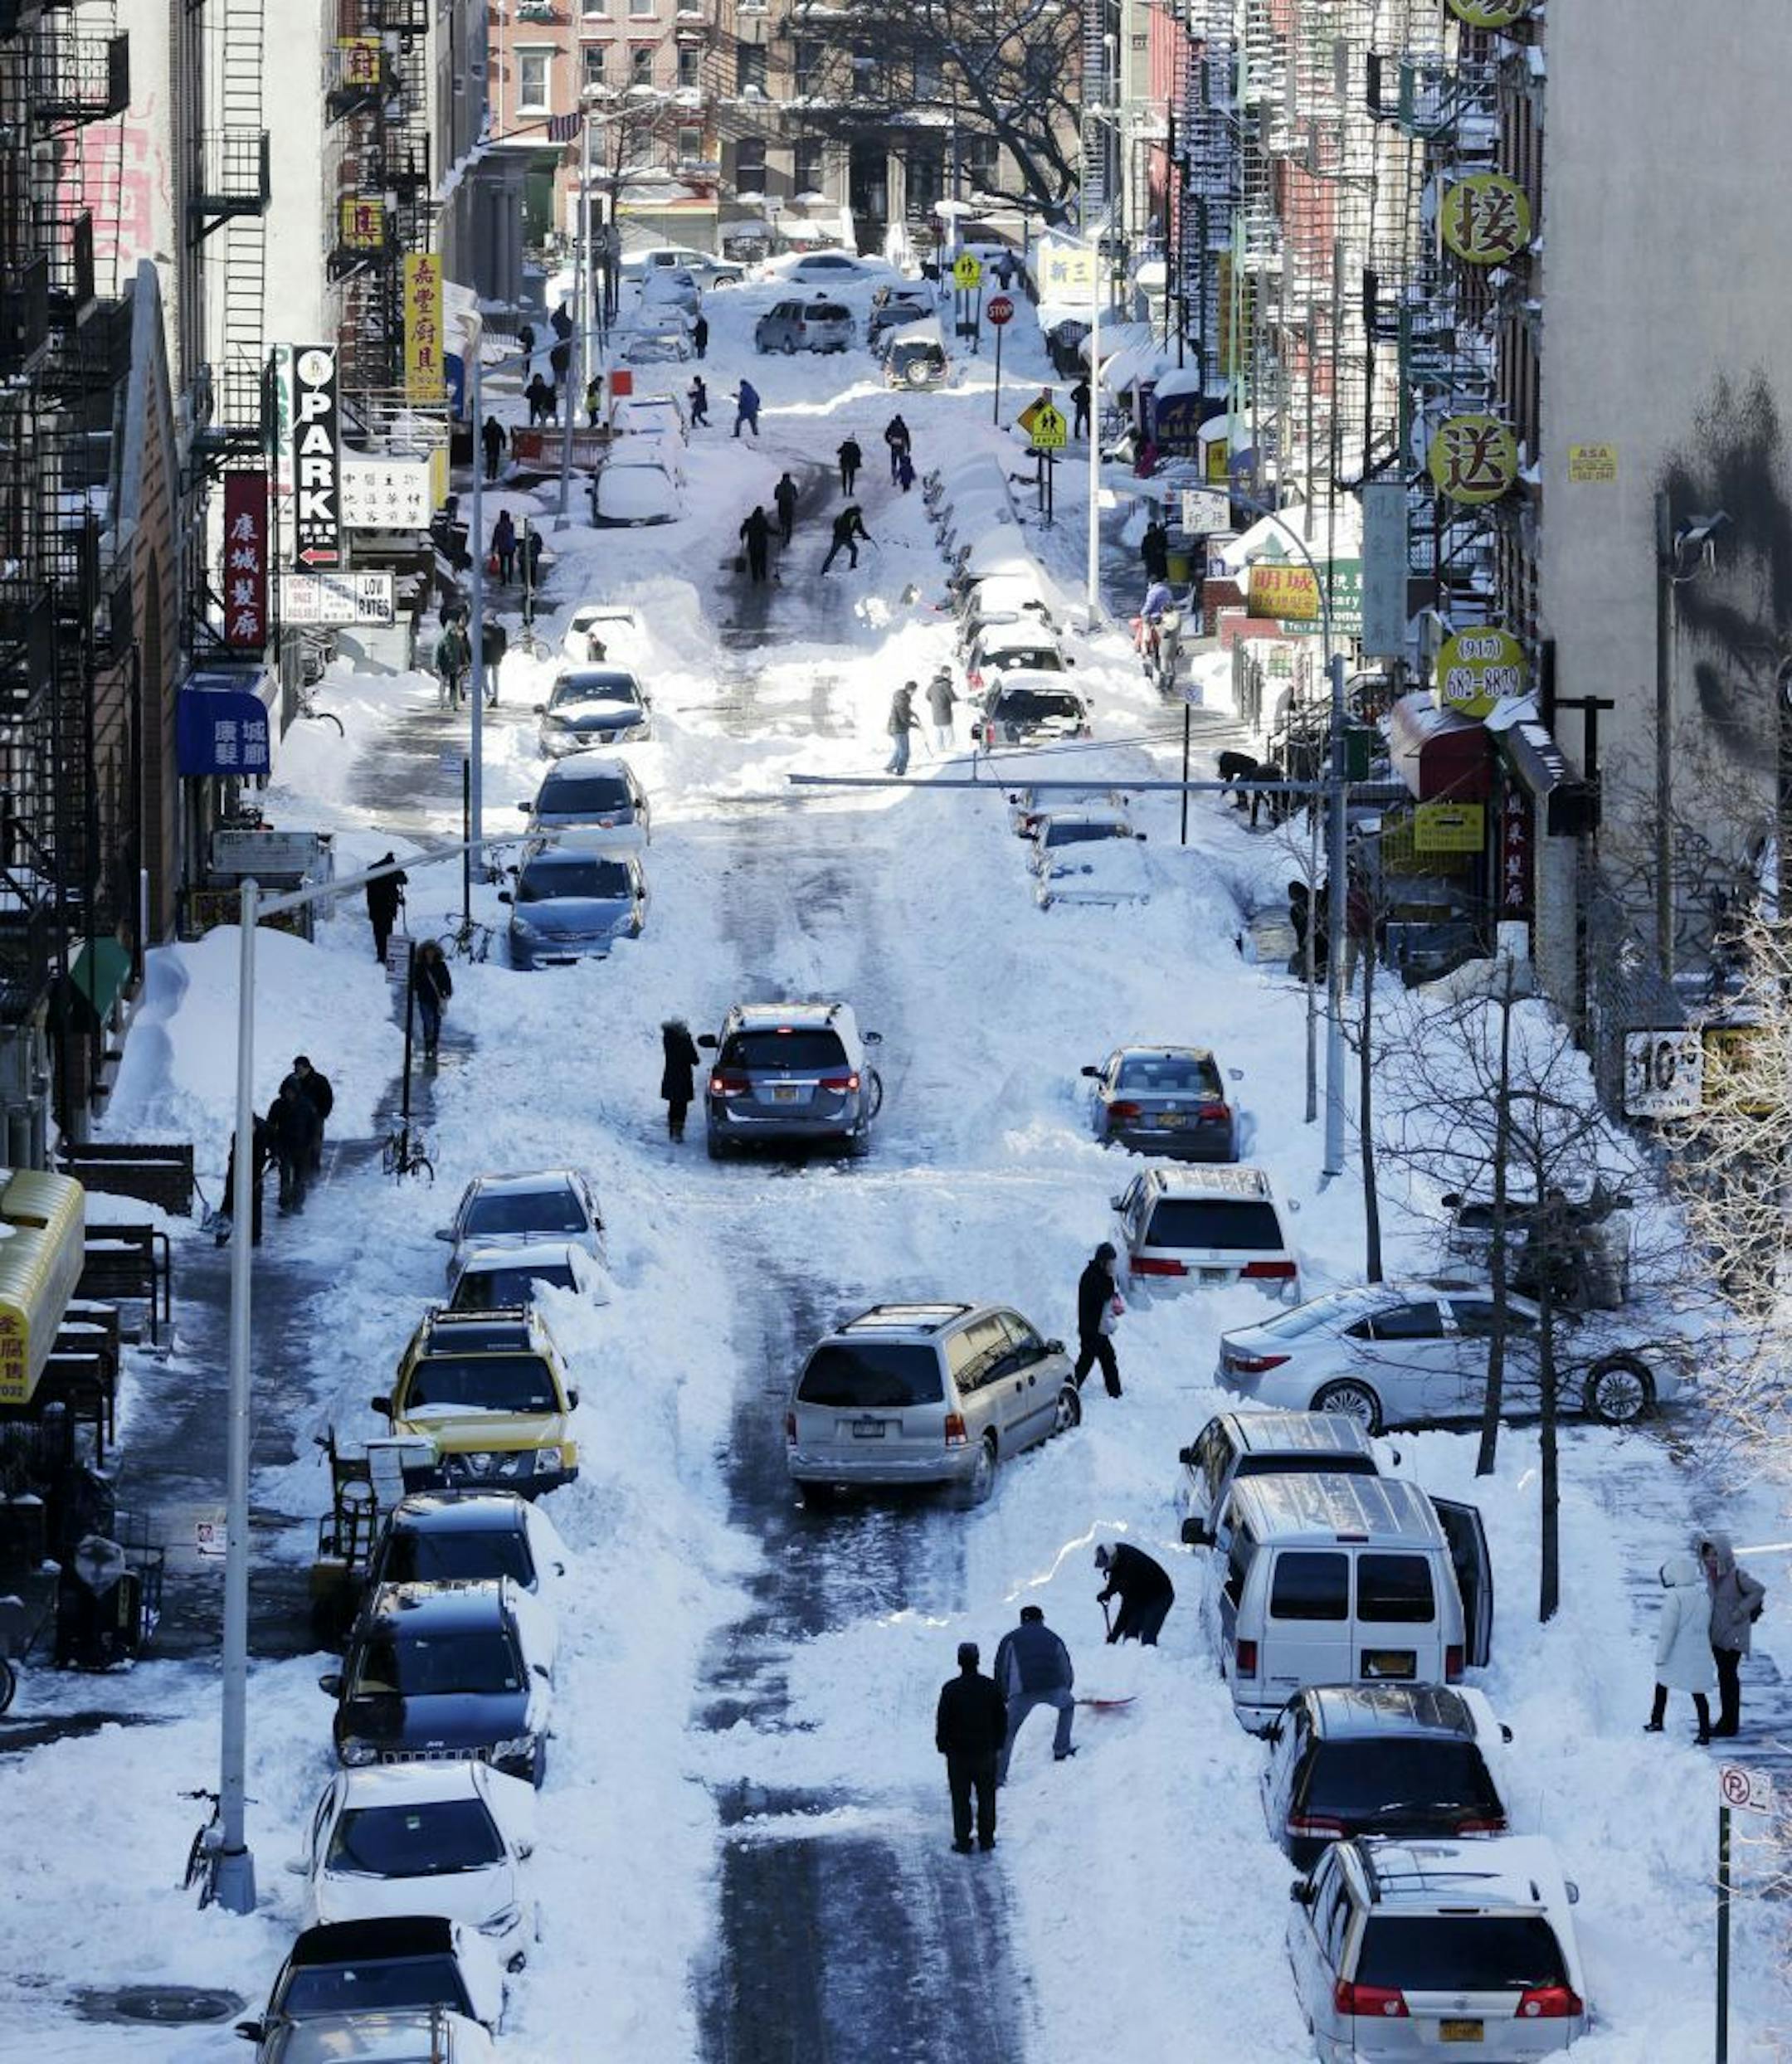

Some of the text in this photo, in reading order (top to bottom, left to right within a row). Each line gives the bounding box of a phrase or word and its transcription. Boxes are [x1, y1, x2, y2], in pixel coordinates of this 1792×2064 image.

[1454, 185, 1518, 252] 接
[988, 305, 1012, 318] STOP
[299, 392, 334, 520] PARK
[1444, 425, 1506, 492] 送
[1459, 638, 1502, 660] (917)
